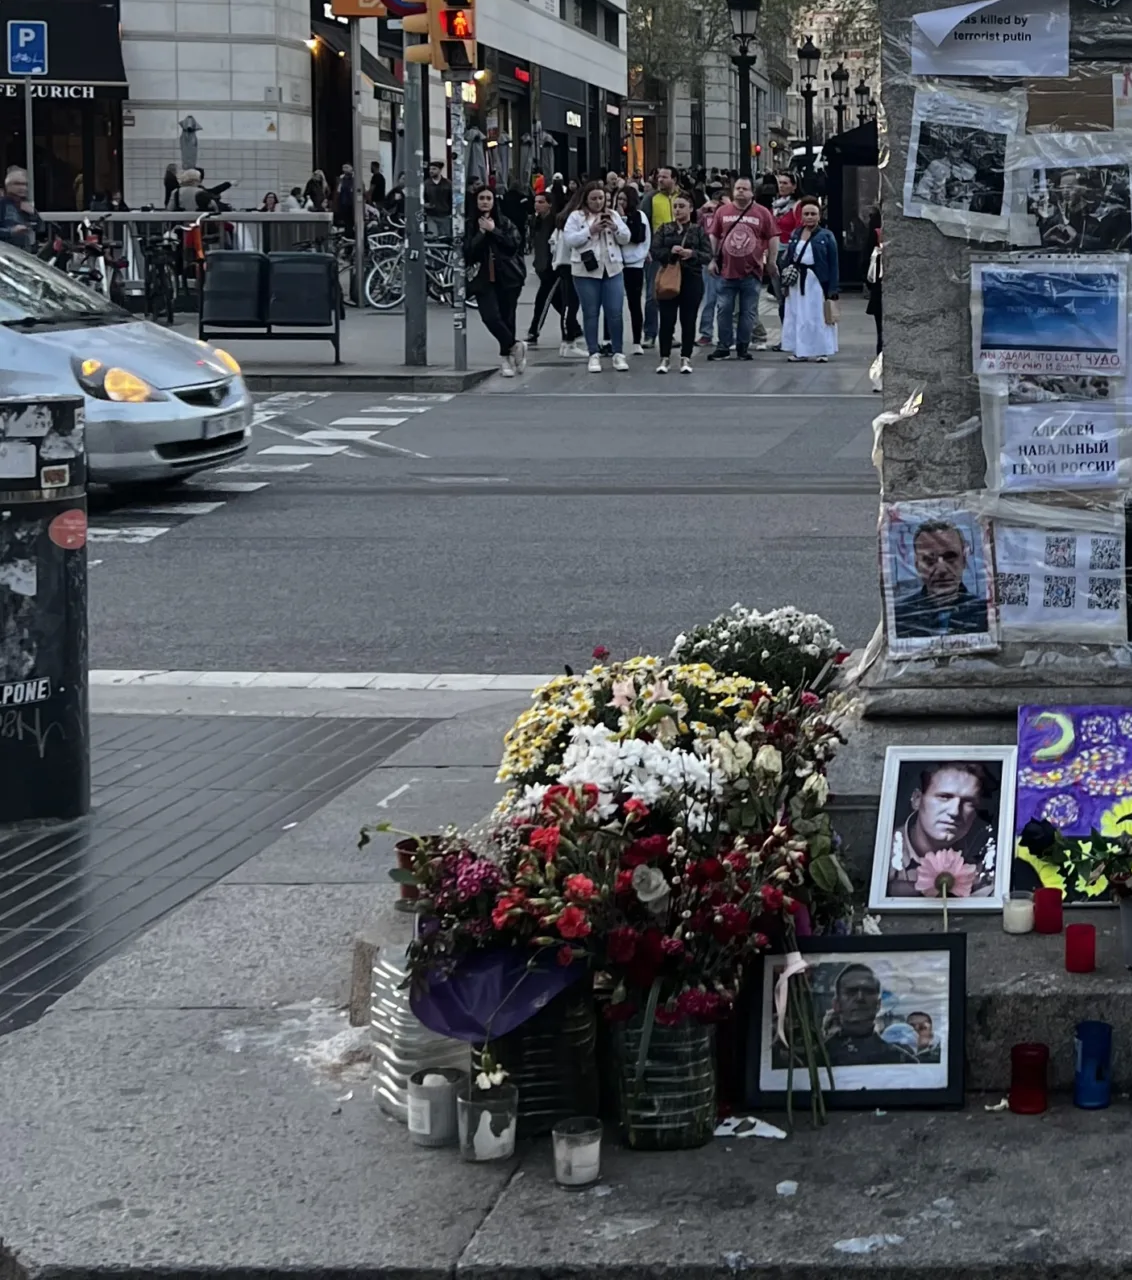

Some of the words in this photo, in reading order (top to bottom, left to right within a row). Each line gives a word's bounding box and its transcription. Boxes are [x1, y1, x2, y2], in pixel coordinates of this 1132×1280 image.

[980, 14, 1011, 25] killed
[1014, 15, 1028, 27] by
[19, 28, 36, 48] P
[954, 31, 1000, 41] terrorist
[1003, 31, 1032, 43] putin
[30, 85, 95, 99] ZURICH
[1085, 354, 1120, 366] ЧУДО
[1031, 421, 1094, 437] АЛЕКСЕЙ
[1018, 440, 1109, 456] НАВАЛЬНЫЙ
[1012, 460, 1056, 475] ГЕРОЙ
[1061, 460, 1116, 473] РОССИИ
